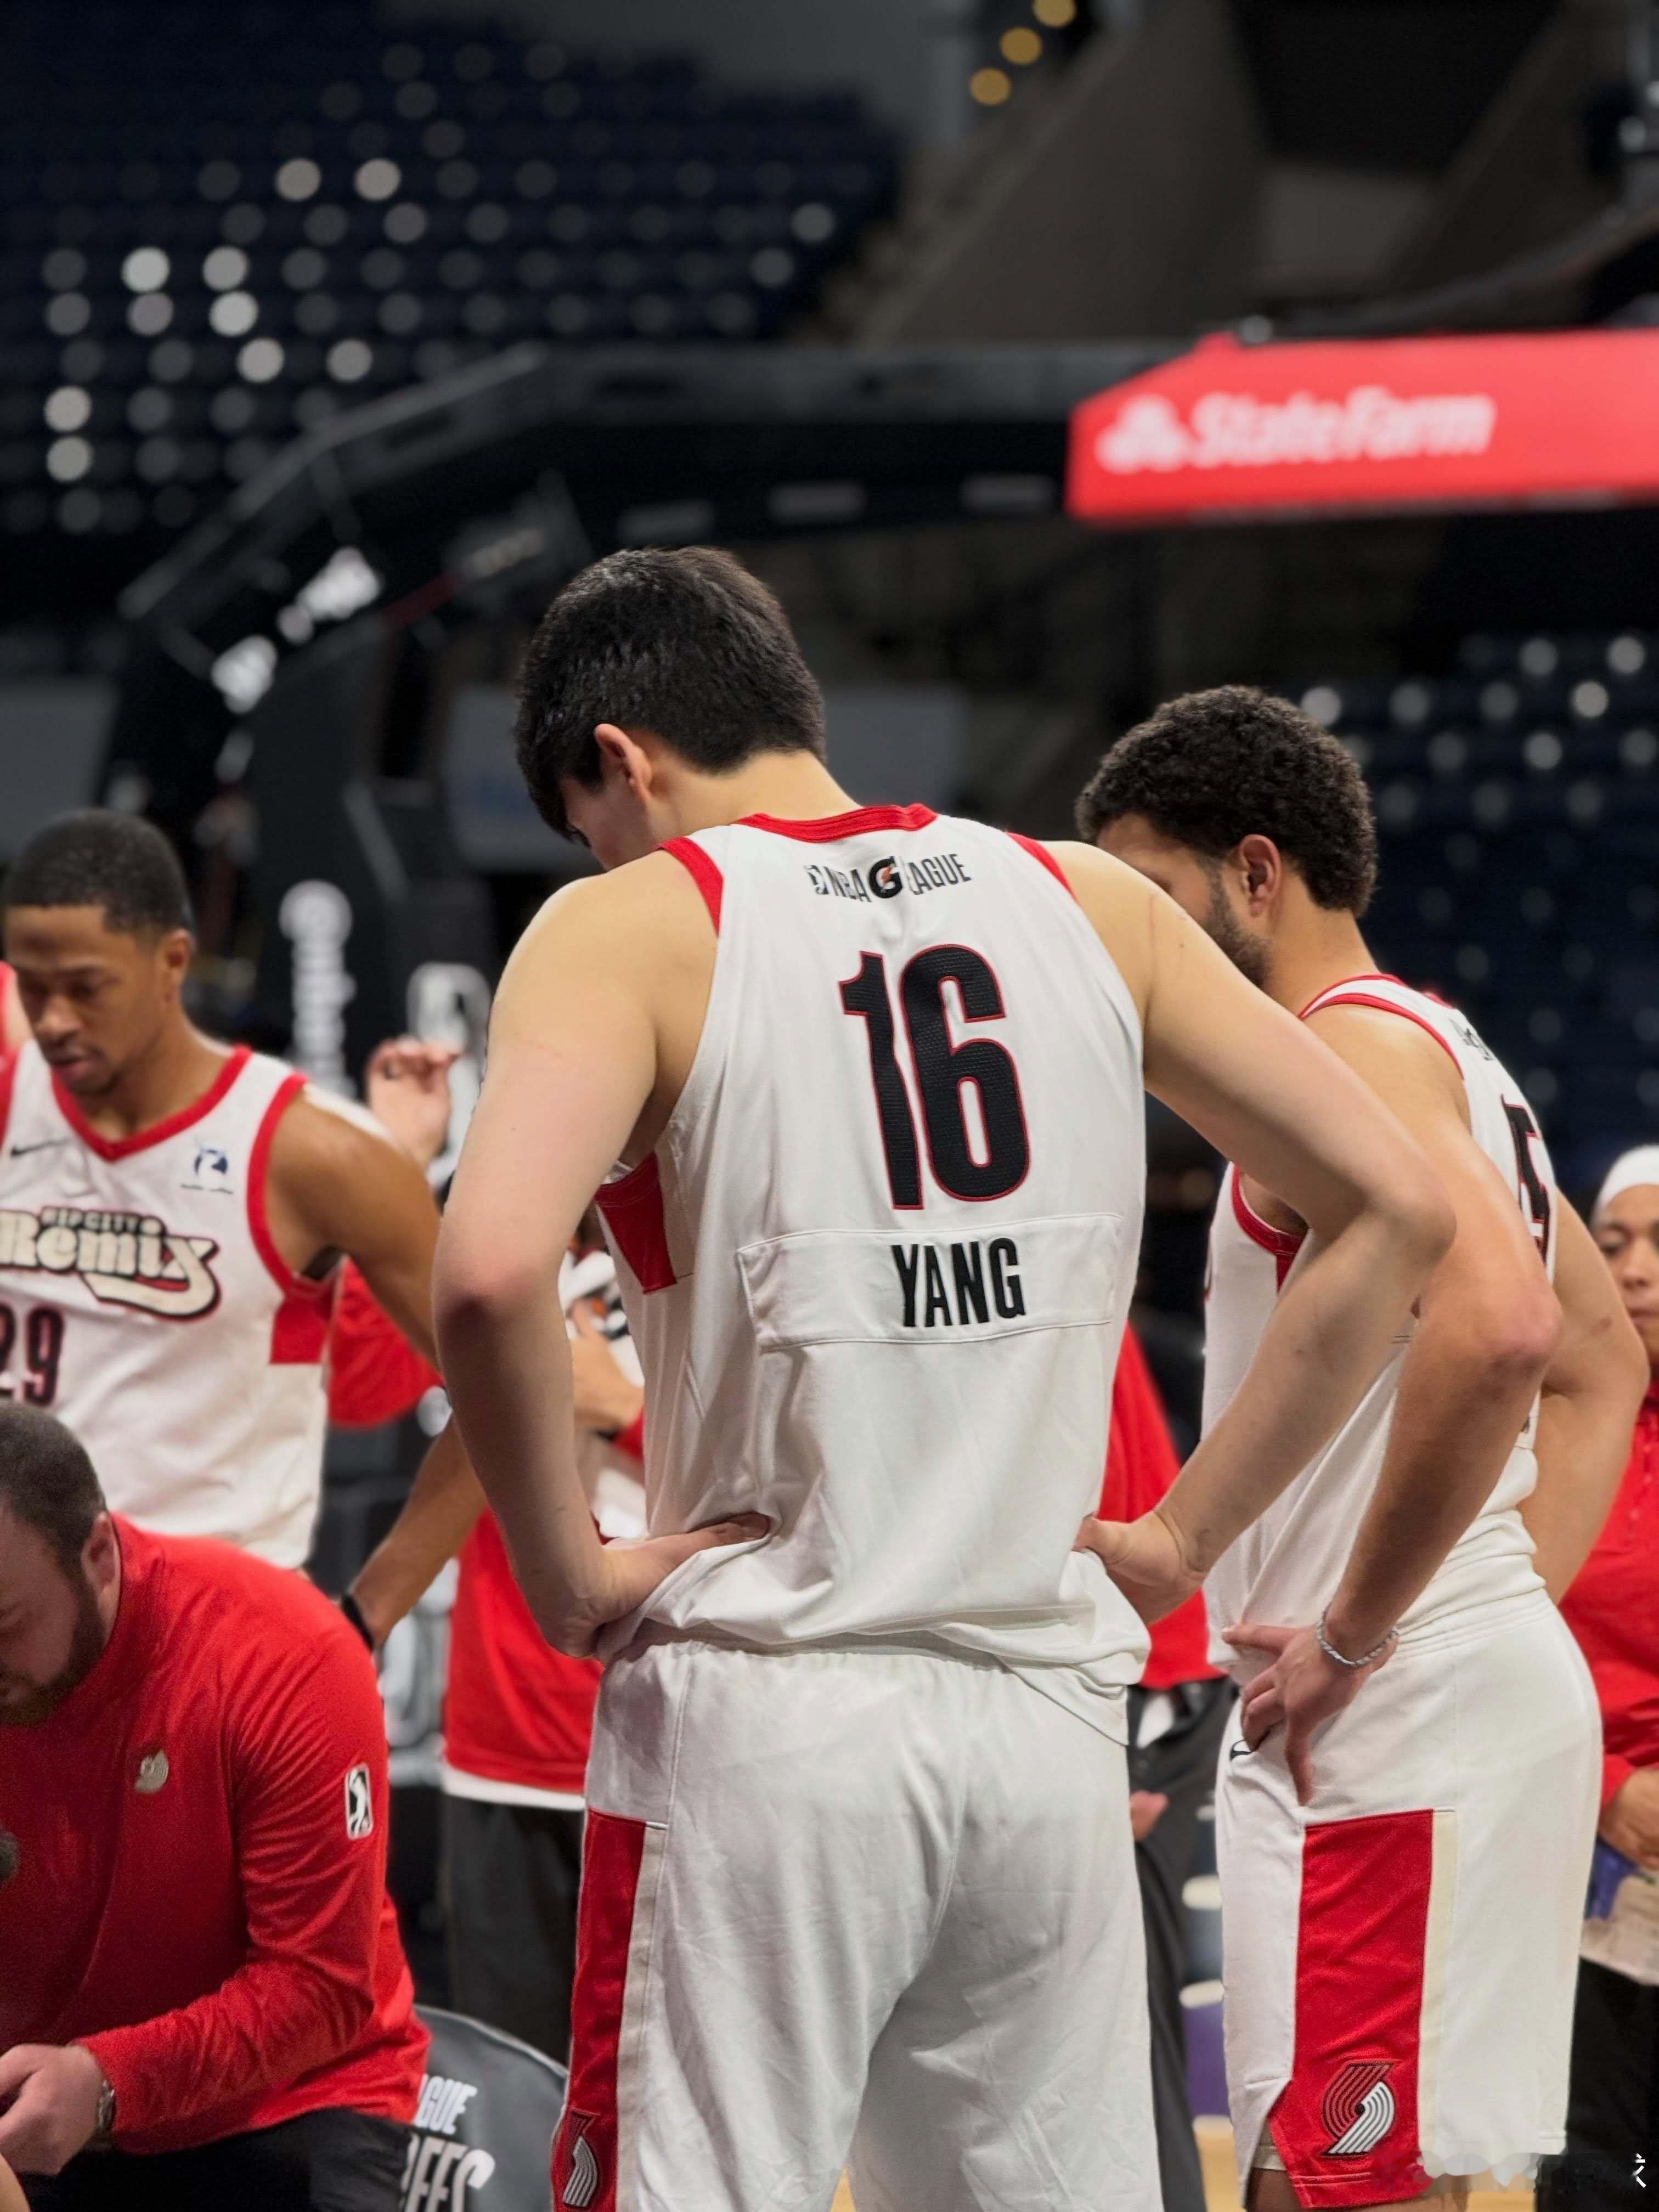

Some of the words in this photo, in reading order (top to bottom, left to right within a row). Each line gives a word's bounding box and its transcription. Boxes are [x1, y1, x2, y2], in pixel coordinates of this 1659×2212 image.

[902, 854, 972, 895] AGUE
[838, 944, 1031, 1210] 16
[890, 1237, 1026, 1328] YANG
[415, 2074, 478, 2135] GUE
